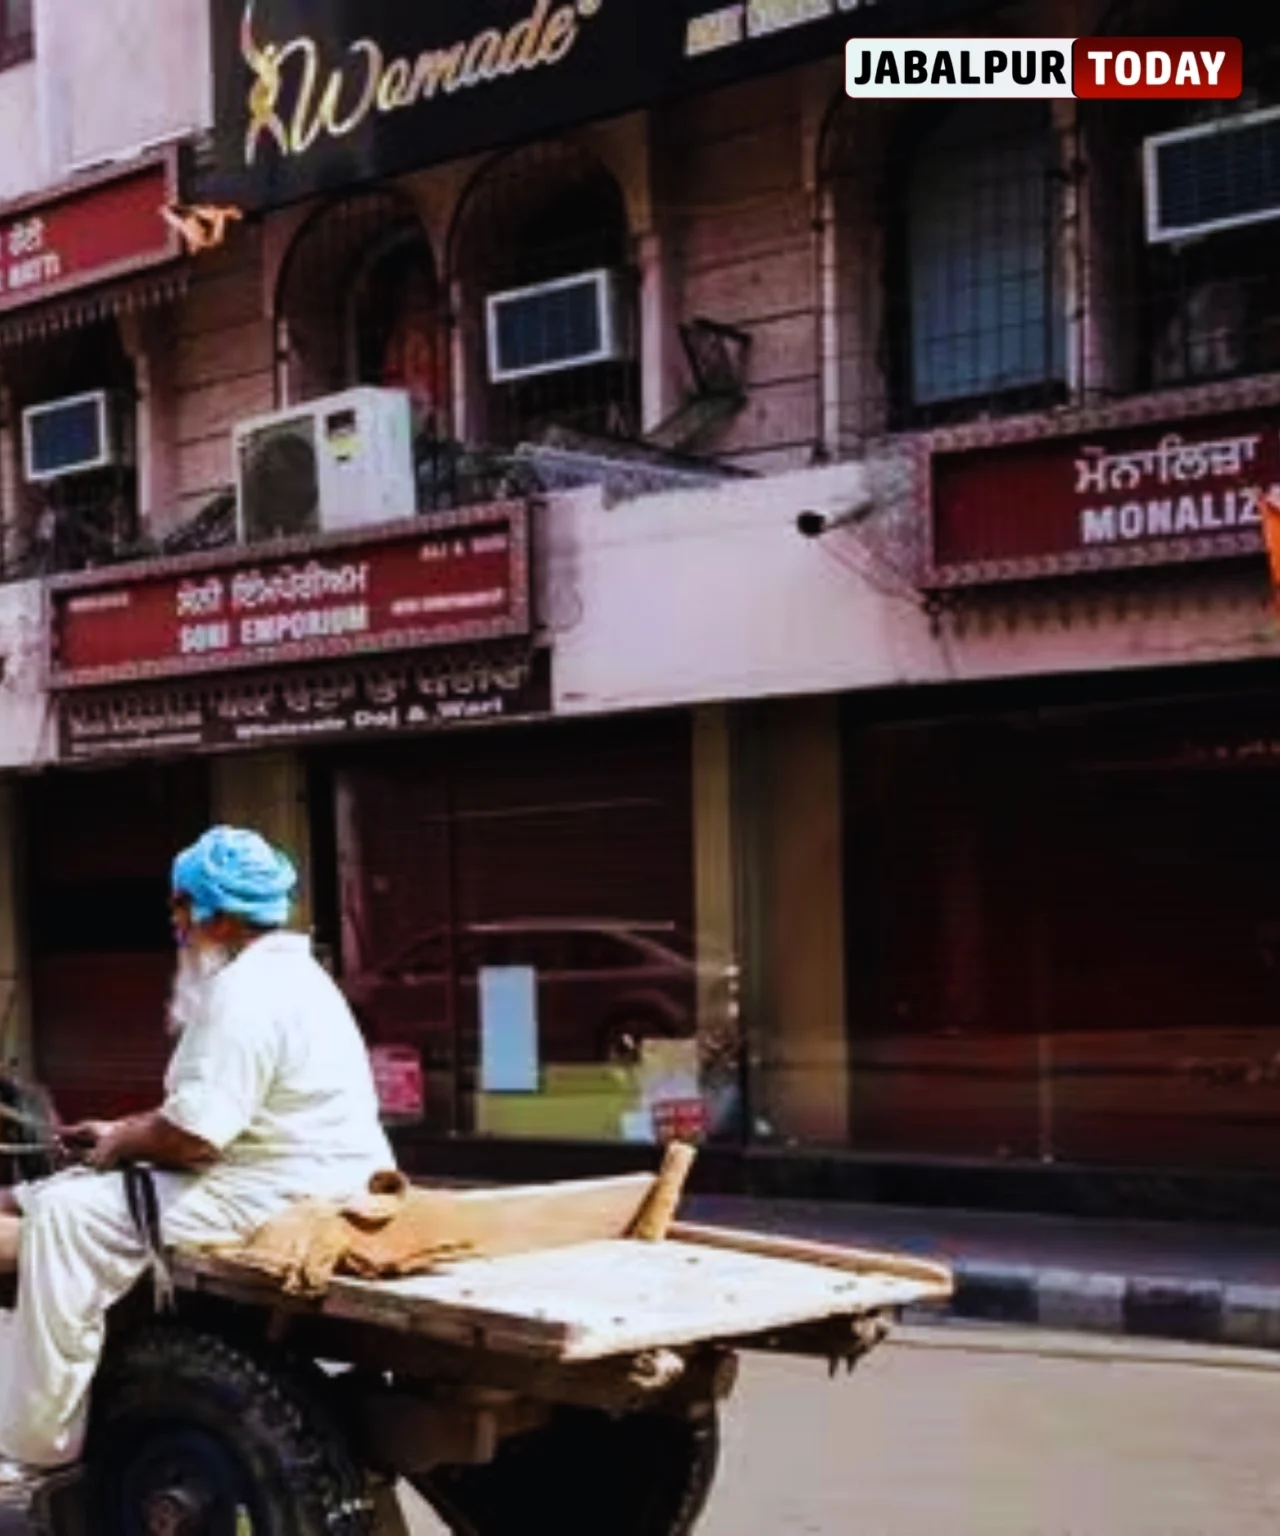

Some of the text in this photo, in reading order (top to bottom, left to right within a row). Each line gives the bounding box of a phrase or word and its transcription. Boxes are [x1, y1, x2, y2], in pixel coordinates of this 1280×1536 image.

[273, 0, 577, 152] Womade
[1081, 488, 1262, 545] MONALIZ
[241, 603, 368, 645] EMPORIUM
